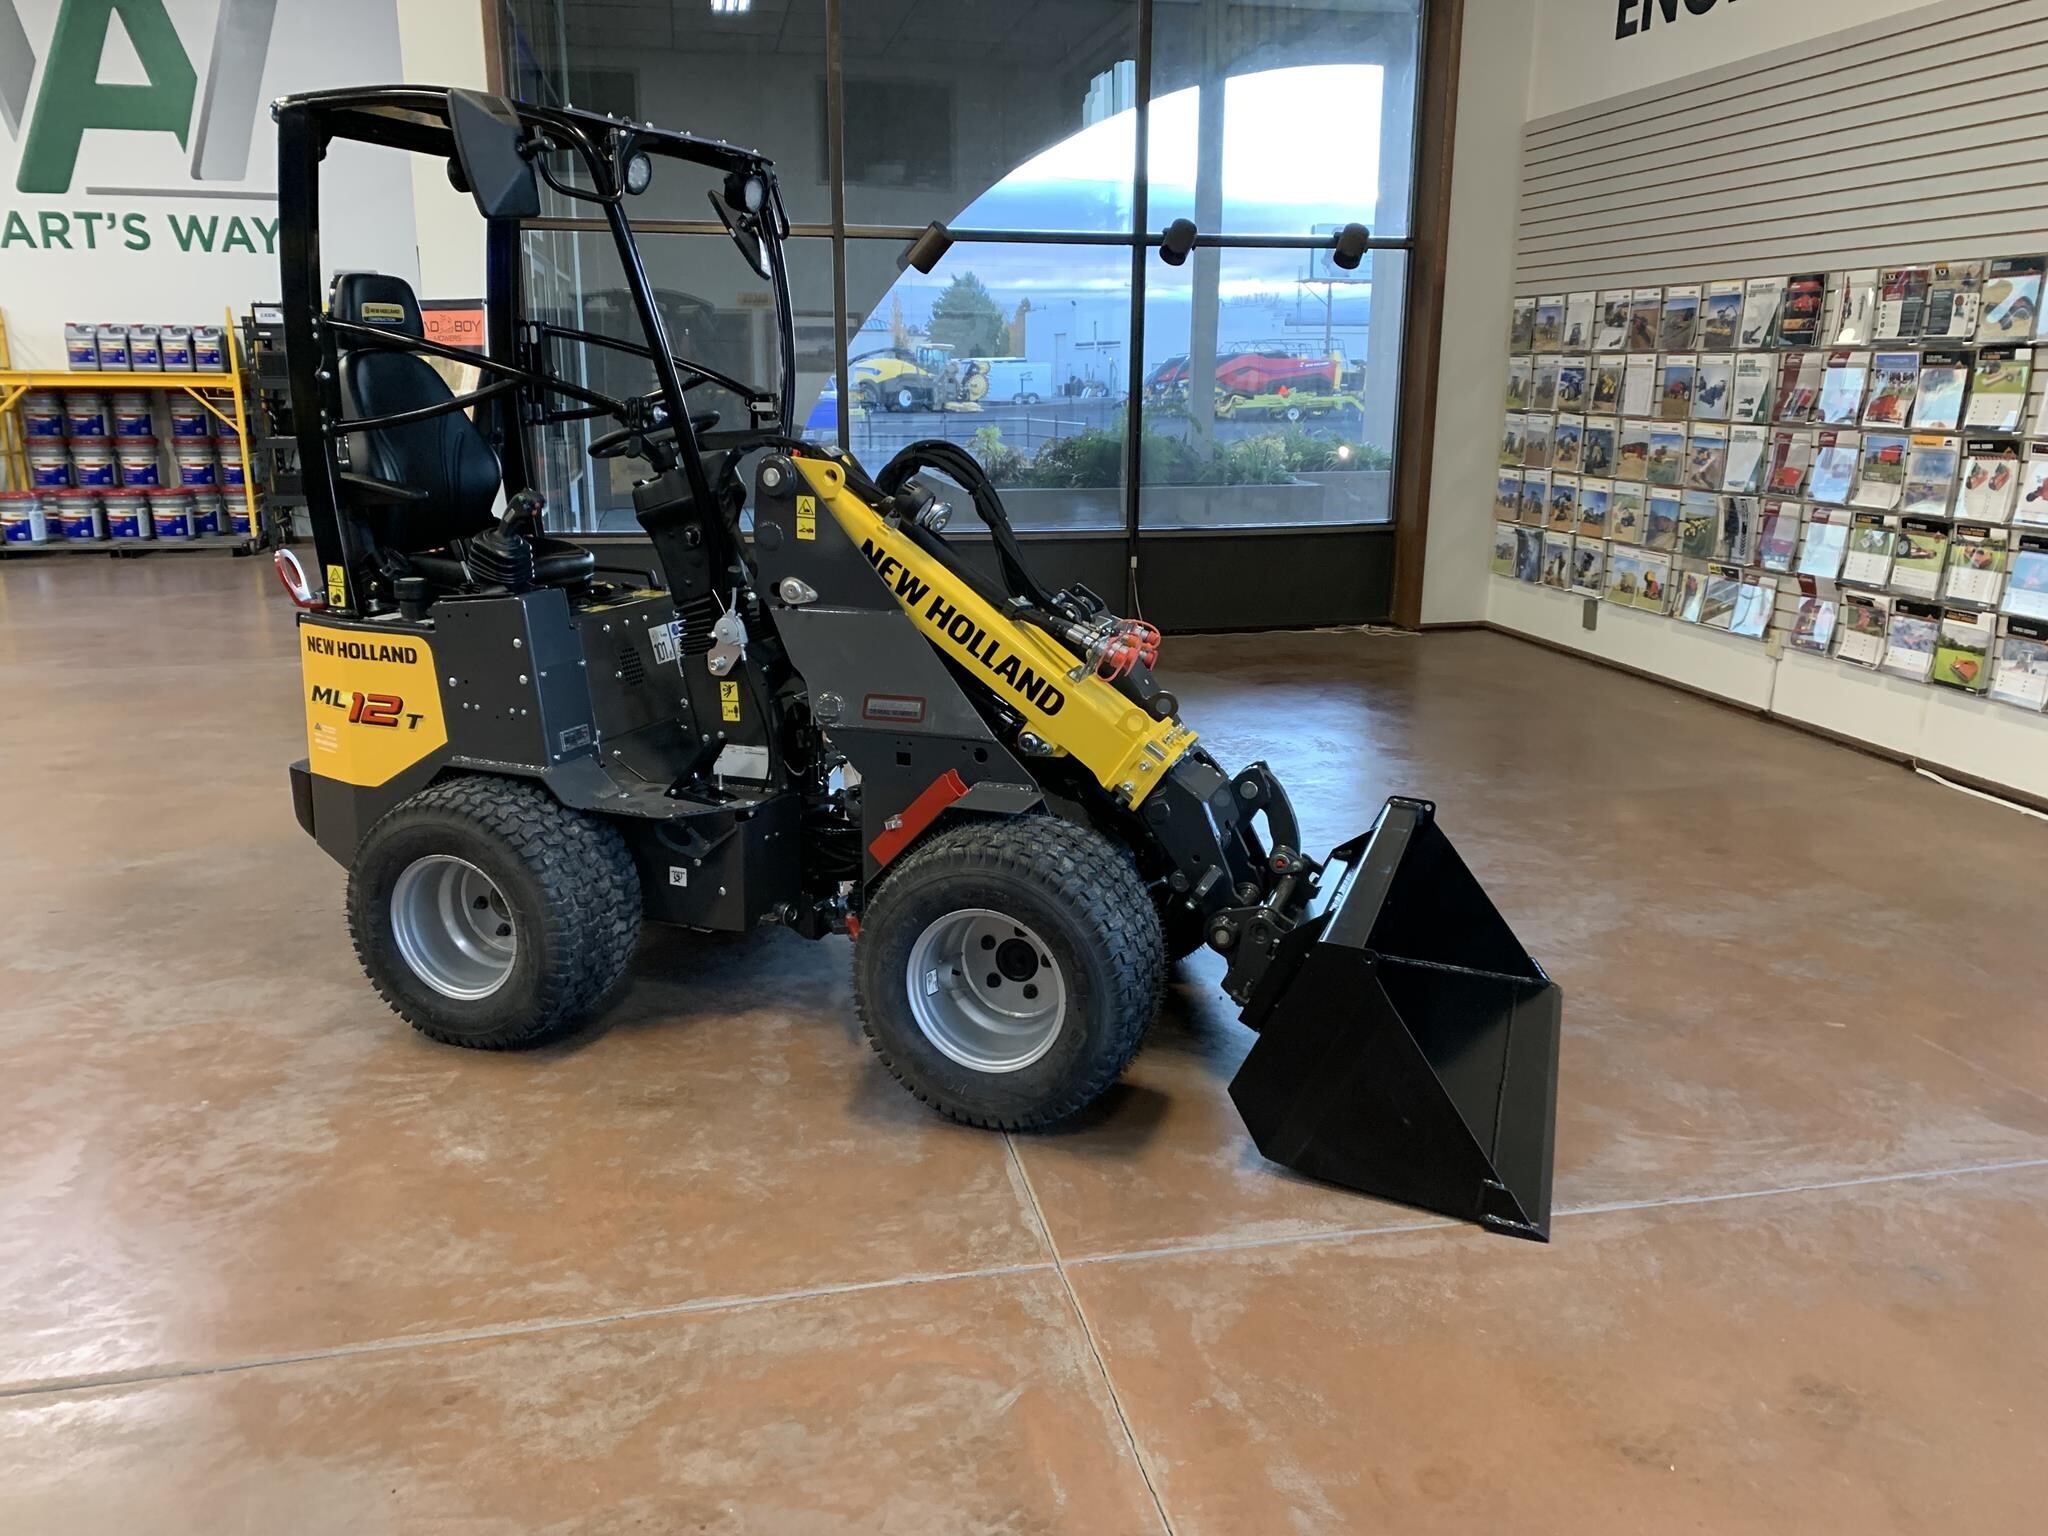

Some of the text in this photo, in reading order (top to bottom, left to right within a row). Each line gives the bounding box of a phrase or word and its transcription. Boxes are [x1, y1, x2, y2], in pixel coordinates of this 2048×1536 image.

[0, 210, 279, 254] ART'S WAY
[455, 320, 481, 332] BOY
[861, 538, 1065, 716] NEW HOLLAND
[307, 635, 418, 665] NEW HOLLAND
